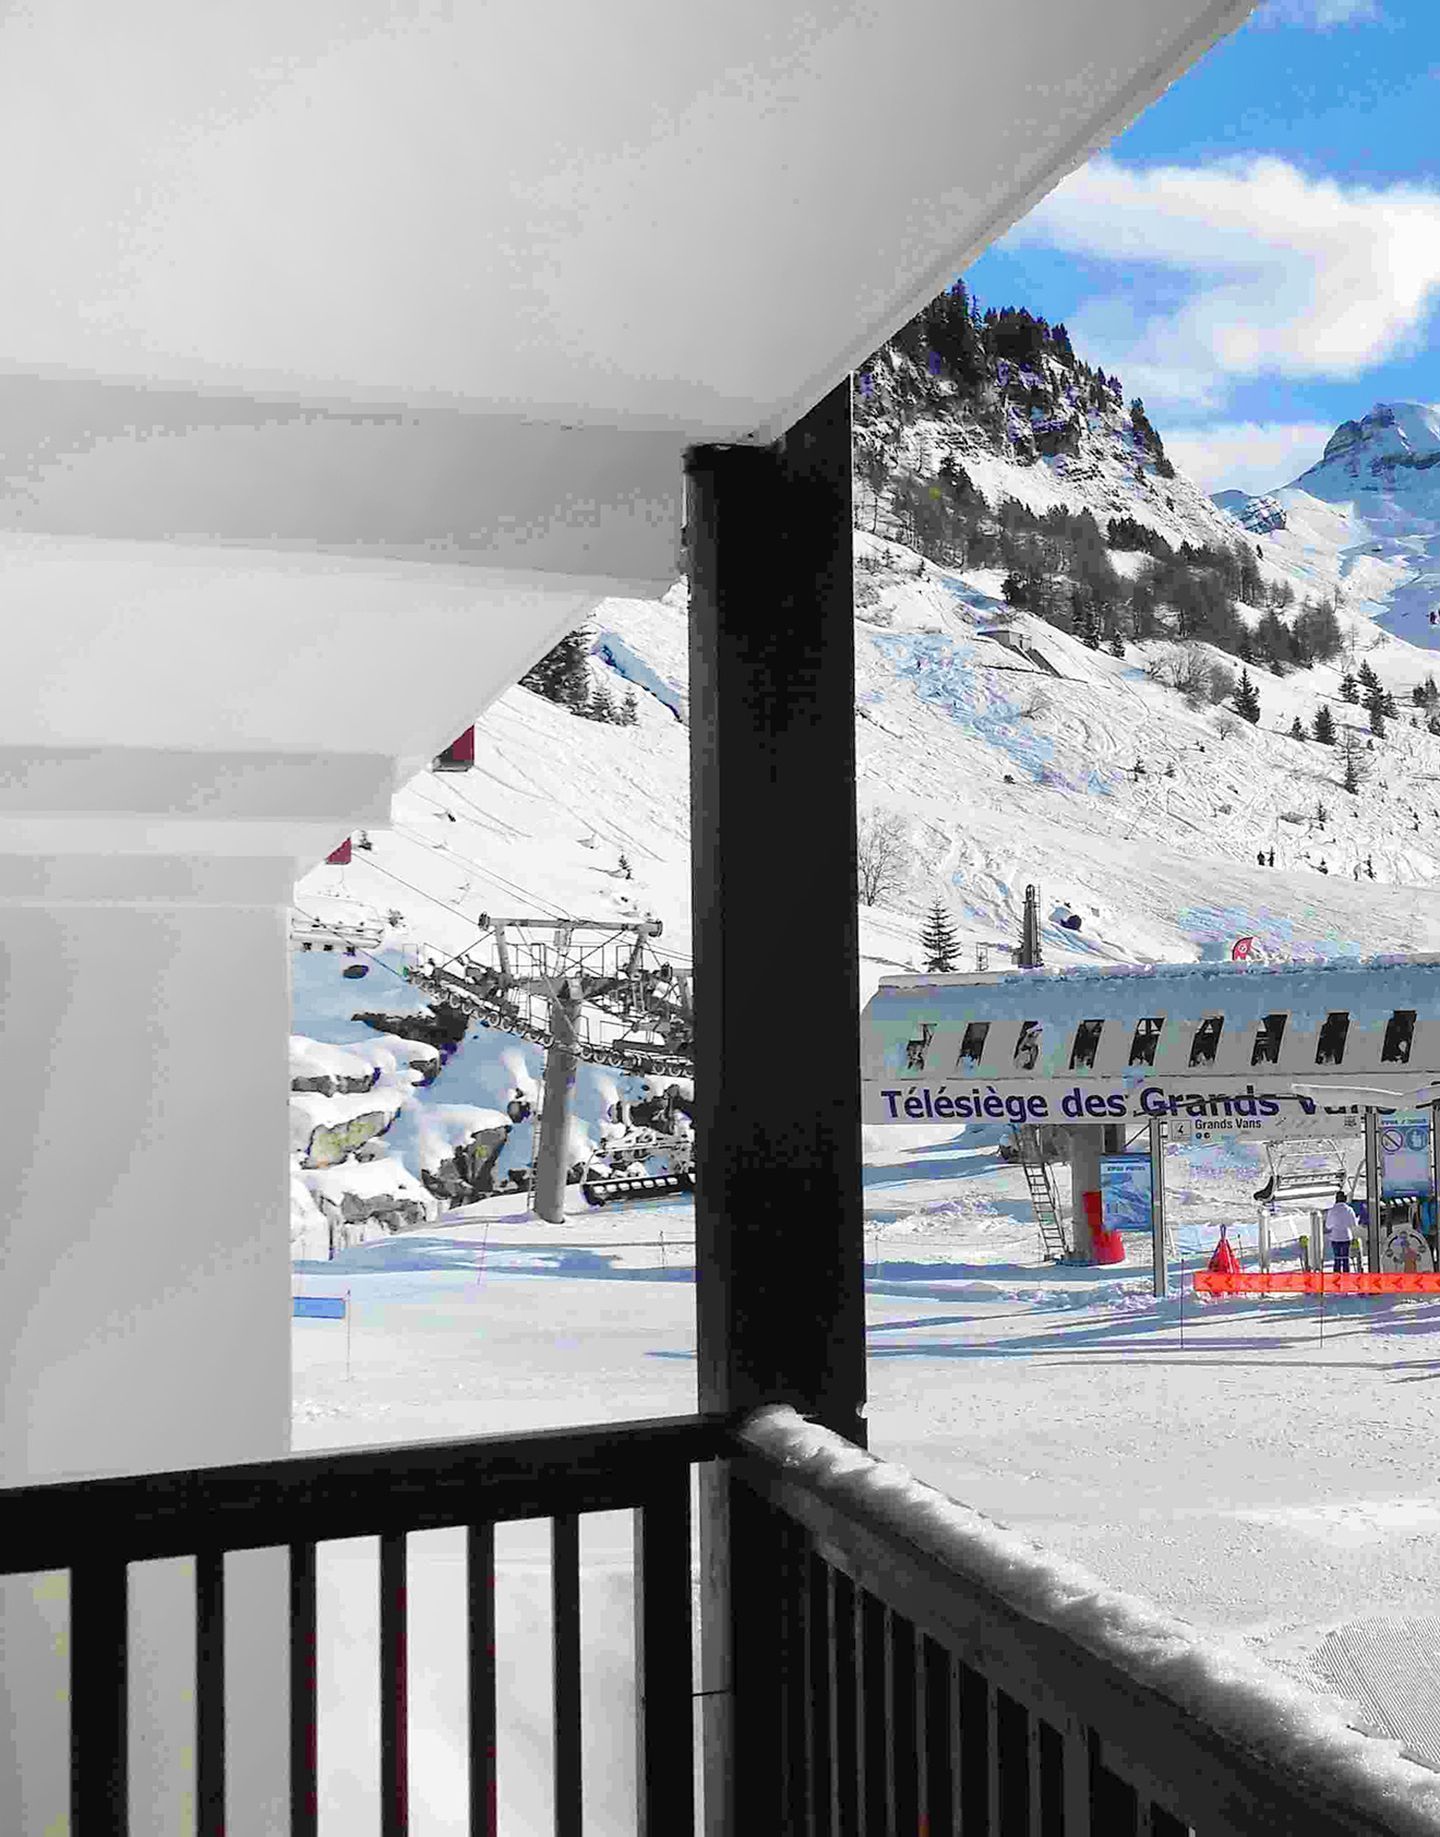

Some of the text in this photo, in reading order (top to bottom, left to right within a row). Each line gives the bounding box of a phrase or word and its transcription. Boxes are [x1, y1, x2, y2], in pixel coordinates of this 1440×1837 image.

[881, 1086, 1048, 1123] Télésiège
[1061, 1088, 1127, 1117] des
[1140, 1085, 1280, 1117] Grands
[1195, 1118, 1262, 1130] Grands Vans
